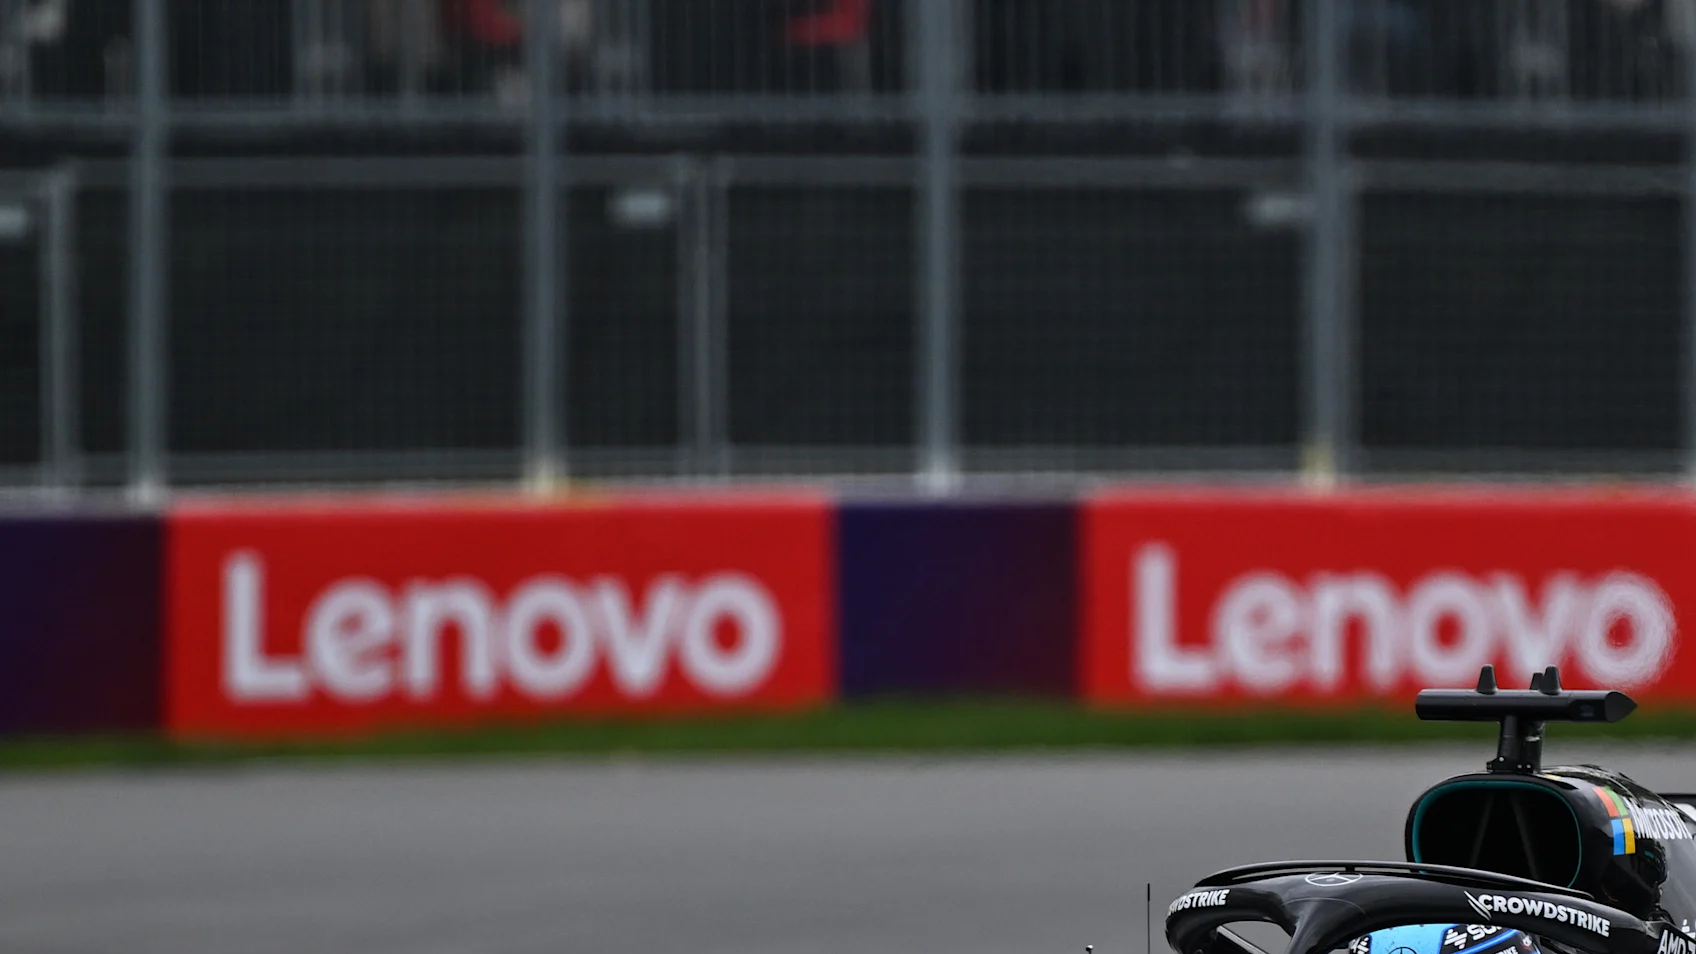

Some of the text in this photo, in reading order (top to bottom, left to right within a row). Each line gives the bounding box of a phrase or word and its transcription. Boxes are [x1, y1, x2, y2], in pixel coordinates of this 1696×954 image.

[222, 548, 783, 704] Lenovo
[1132, 541, 1676, 691] Lenovo
[1480, 894, 1612, 938] CROWDSTRIKE
